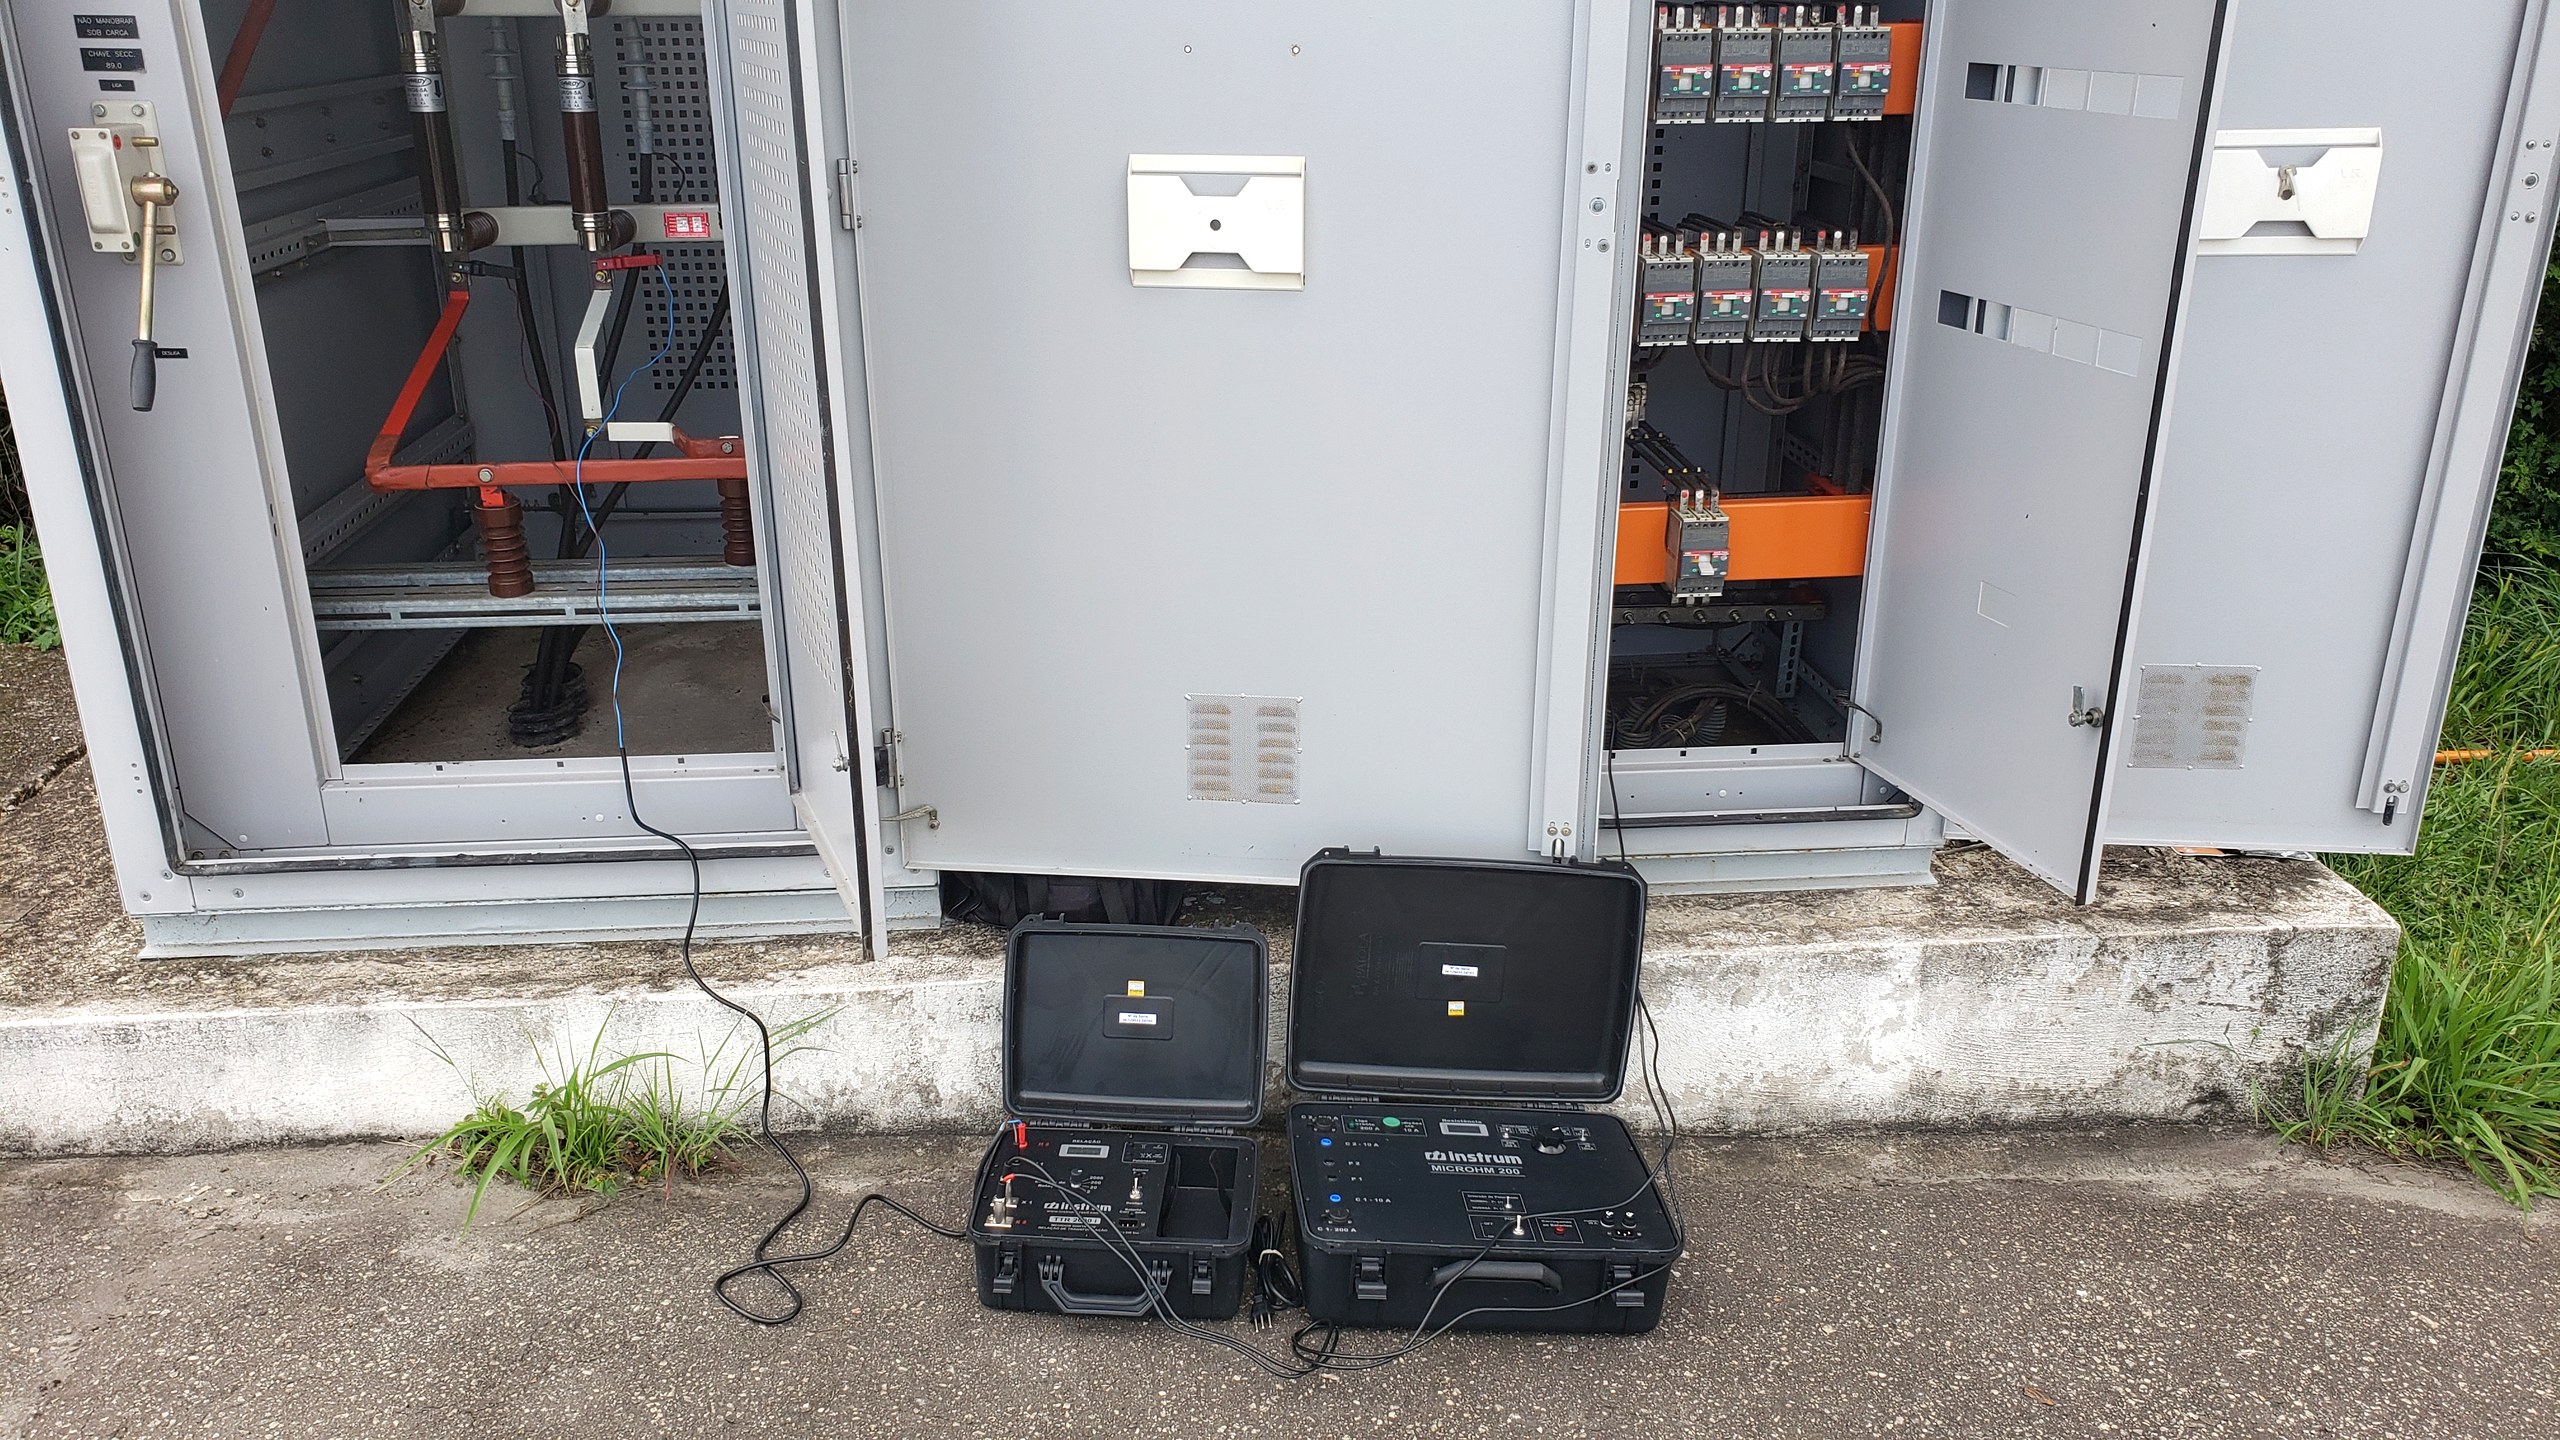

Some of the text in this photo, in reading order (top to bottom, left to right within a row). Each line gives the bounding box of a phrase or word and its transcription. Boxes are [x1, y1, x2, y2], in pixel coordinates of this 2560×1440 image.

[77, 16, 134, 25] NÃO MANOBRAR
[88, 50, 136, 58] CHAVE SECC.
[1431, 1164, 1521, 1175] MICROHM 200
